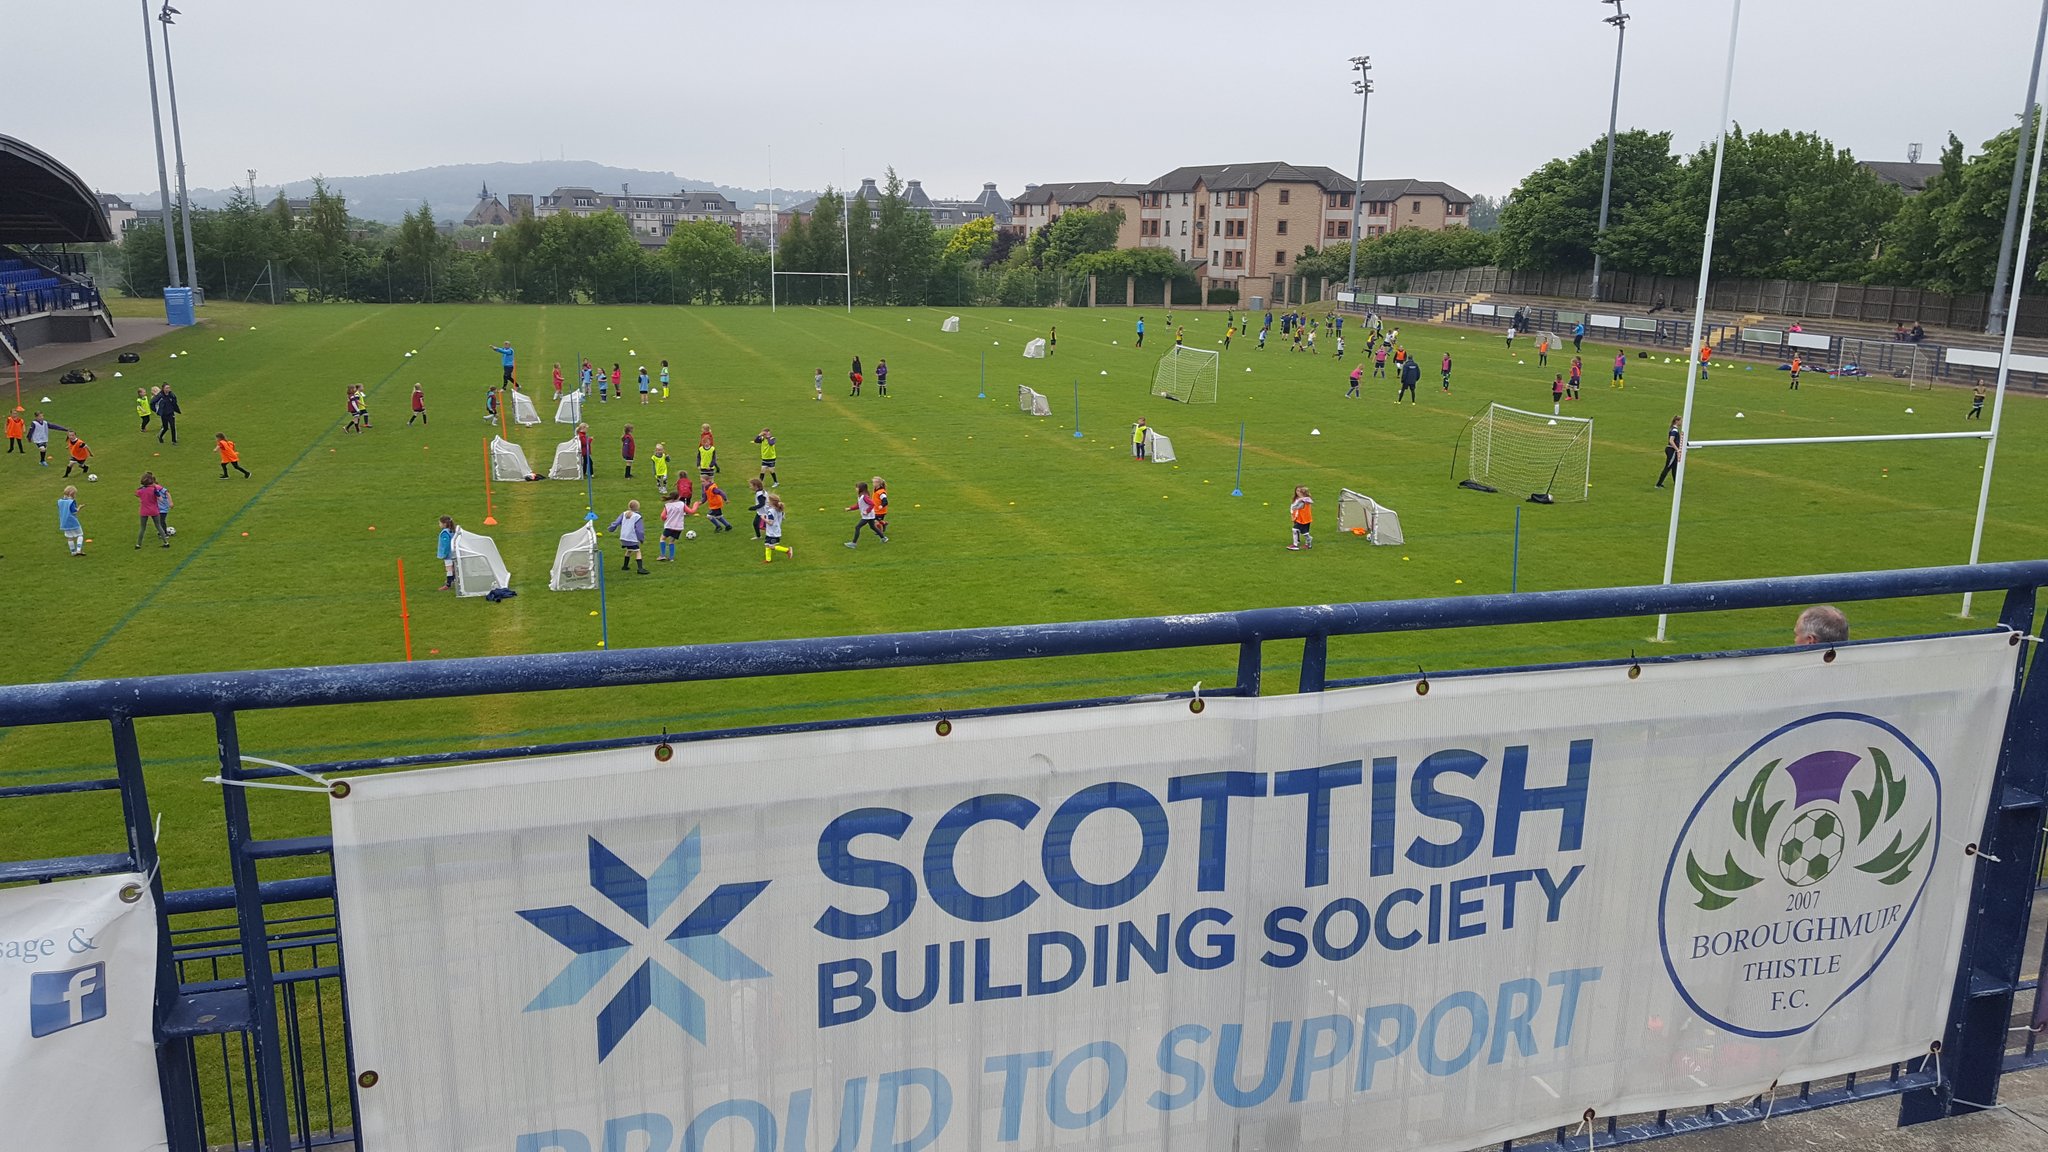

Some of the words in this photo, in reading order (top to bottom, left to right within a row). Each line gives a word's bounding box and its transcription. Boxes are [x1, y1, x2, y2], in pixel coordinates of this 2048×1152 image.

[813, 740, 1593, 940] SCOTTISH
[1786, 890, 1820, 912] 2007
[67, 927, 98, 954] &
[818, 907, 1235, 1028] BUILDING
[1261, 865, 1585, 968] SOCIETY
[1690, 904, 1901, 959] BOROUGHMUIR
[1743, 954, 1841, 982] THISTLE
[1771, 989, 1809, 1011] F.C.
[516, 1067, 952, 1152] OUD
[984, 1040, 1127, 1143] TO
[1147, 967, 1602, 1110] SUPPORT
